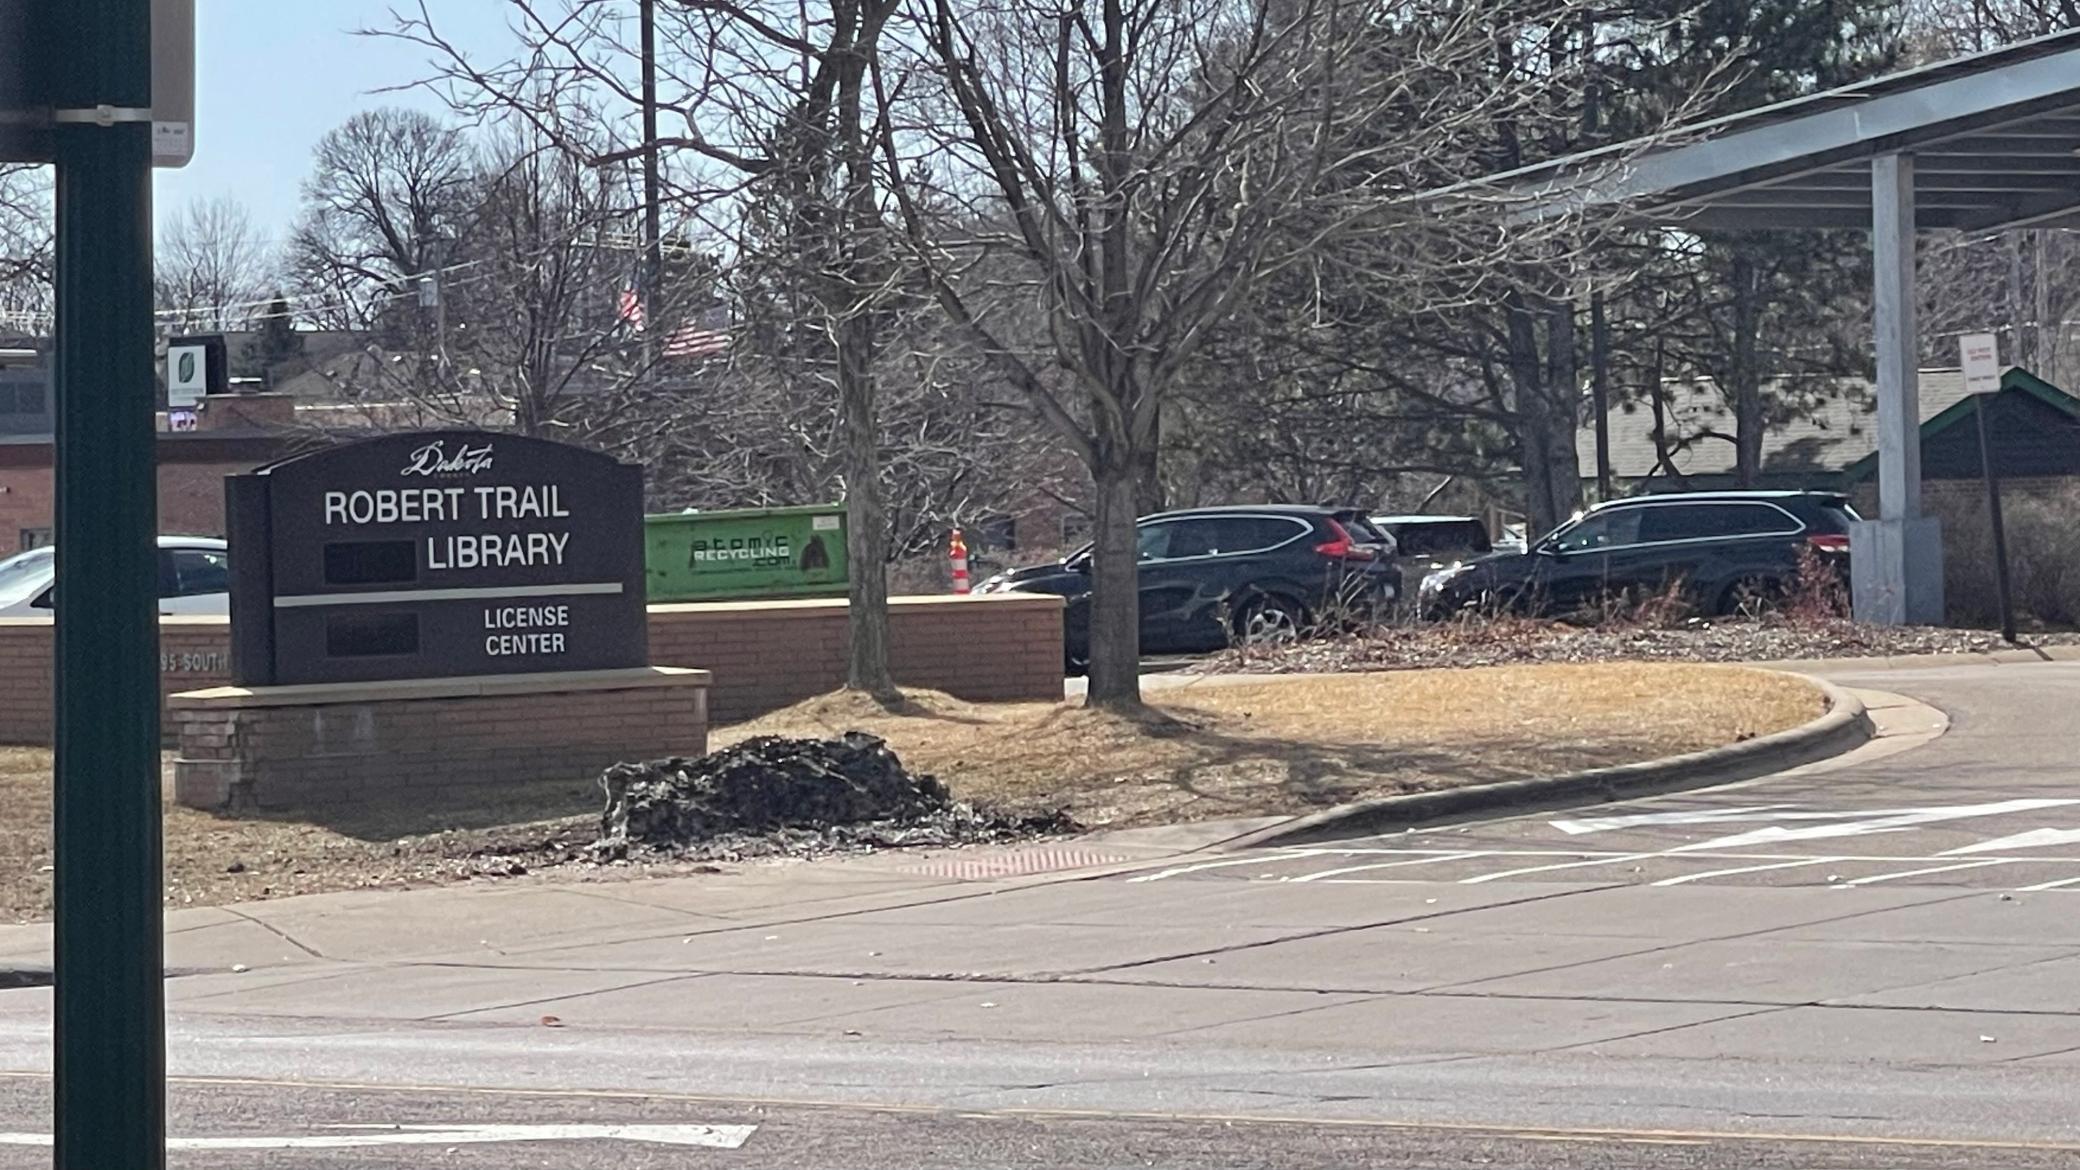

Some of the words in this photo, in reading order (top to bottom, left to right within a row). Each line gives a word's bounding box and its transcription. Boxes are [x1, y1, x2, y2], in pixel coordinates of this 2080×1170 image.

[400, 440, 493, 475] Dakota
[325, 488, 465, 525] ROBERT
[474, 485, 570, 520] TRAIL
[428, 532, 570, 570] LIBRARY
[692, 534, 789, 551] atomic
[693, 546, 790, 561] RECYCLING
[484, 605, 569, 629] LICENSE
[486, 633, 566, 656] CENTER
[183, 653, 228, 672] SOUTH
